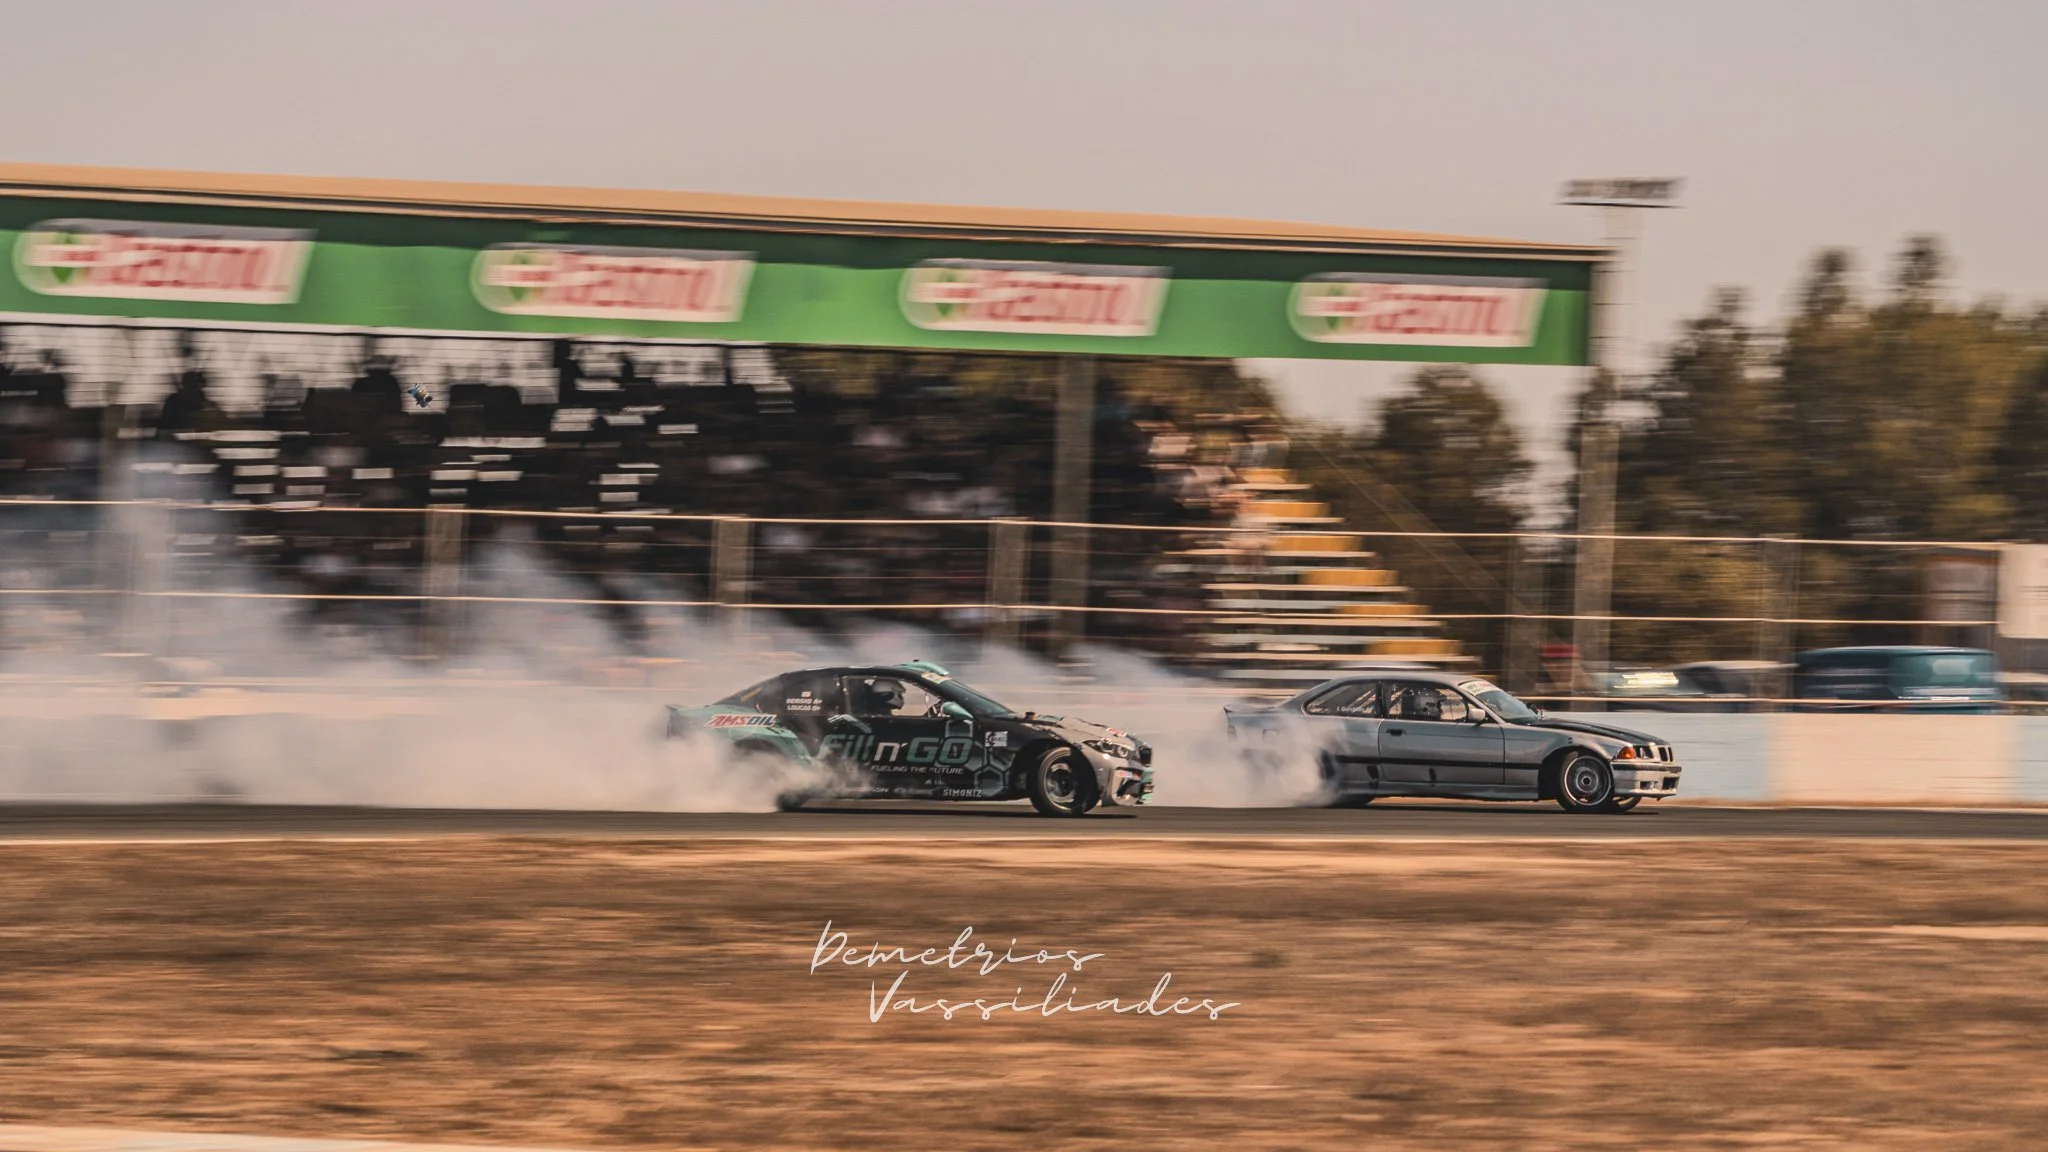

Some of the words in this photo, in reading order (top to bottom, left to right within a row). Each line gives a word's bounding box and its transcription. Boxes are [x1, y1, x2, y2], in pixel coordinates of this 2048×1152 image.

[707, 715, 775, 727] AMSOIL
[906, 736, 974, 765] GO
[943, 788, 982, 798] SIMONIZ
